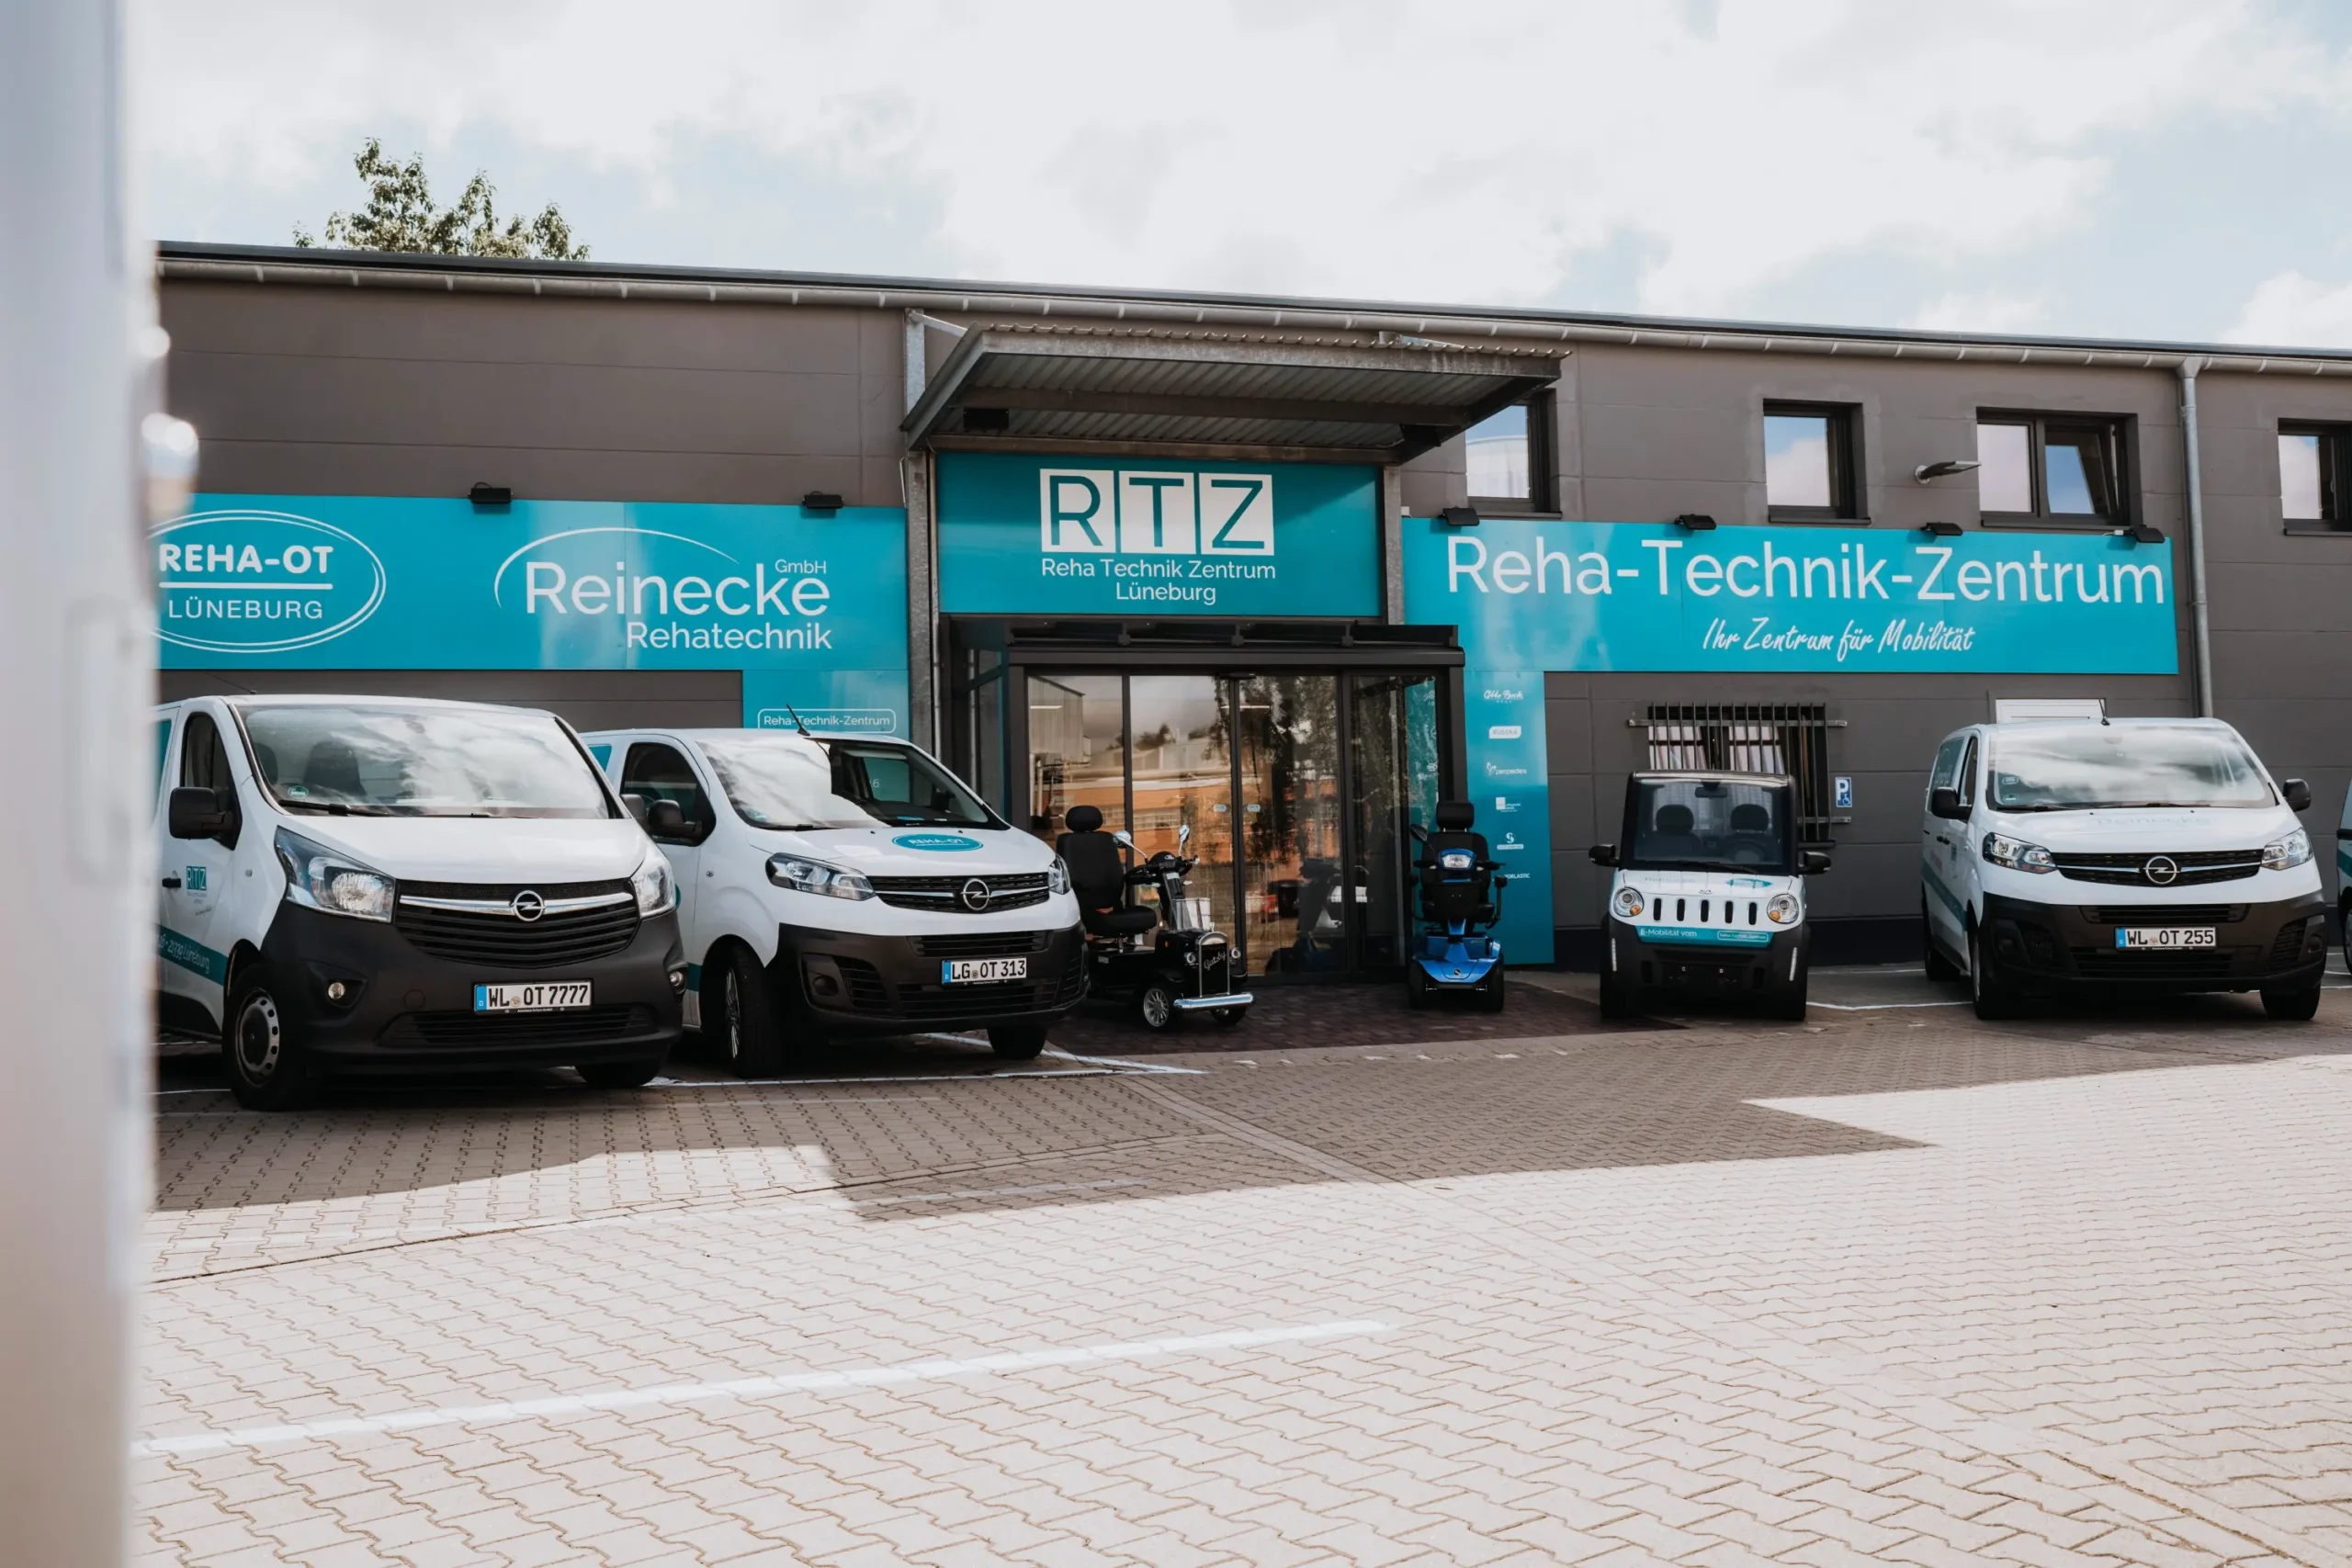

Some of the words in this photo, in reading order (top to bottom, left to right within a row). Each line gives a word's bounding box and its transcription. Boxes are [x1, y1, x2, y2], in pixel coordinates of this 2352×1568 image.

[1049, 475, 1265, 549] RTZ
[159, 544, 334, 574] REHA-OT
[775, 558, 827, 574] GmbH
[1042, 558, 1095, 577] Reha
[1100, 558, 1182, 578] Technik
[1188, 560, 1276, 579] Zentrum
[1447, 536, 2165, 604] Reha-Technik-Zentrum
[526, 561, 830, 615] Reinecke
[1116, 582, 1216, 605] Lüneburg
[169, 595, 322, 619] LÜNEBURG
[627, 621, 832, 649] Rehatechnik
[1702, 617, 1740, 649] Ihr
[1744, 616, 1831, 650] Zentrum
[1837, 619, 1873, 662] für
[1877, 618, 1974, 653] Mobilität
[763, 716, 890, 726] Reha-Technik-Zentrum
[1837, 779, 1849, 801] P
[187, 866, 207, 890] RTZ
[1640, 928, 1679, 936] E-Mobilität
[2127, 931, 2148, 944] WL
[2159, 930, 2179, 944] OT
[2184, 930, 2213, 944] 255
[952, 963, 970, 980] LG
[979, 962, 998, 978] OT
[1001, 960, 1025, 976] 313
[489, 987, 510, 1007] WL
[524, 987, 544, 1005] OT
[548, 985, 588, 1005] 7777
